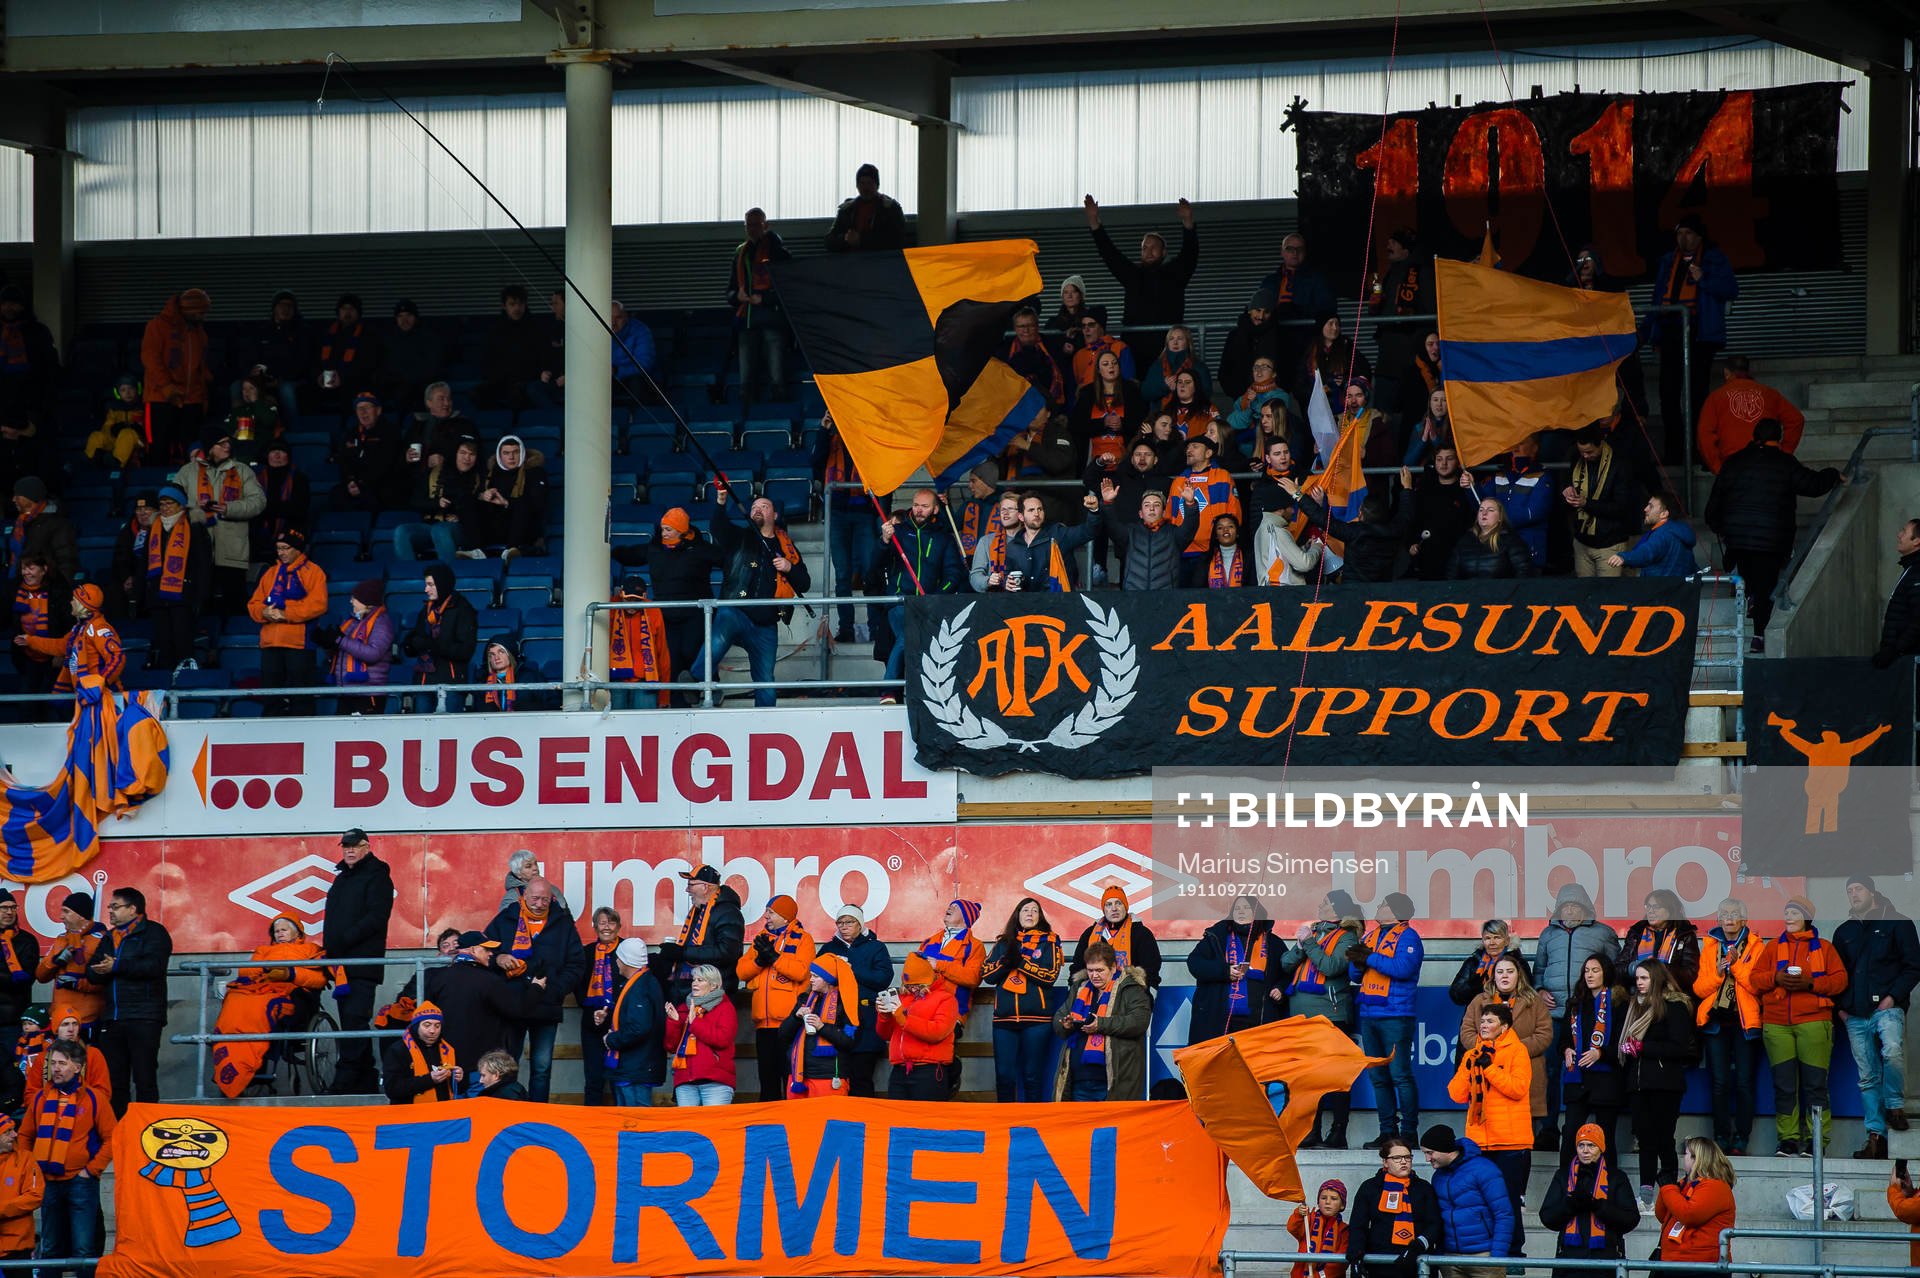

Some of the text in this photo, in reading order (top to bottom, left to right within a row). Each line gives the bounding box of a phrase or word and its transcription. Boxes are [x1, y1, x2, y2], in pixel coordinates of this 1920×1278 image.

[1355, 91, 1768, 276] 1914
[967, 614, 1091, 717] AFK
[1151, 600, 1686, 657] AALESUND
[1175, 685, 1649, 742] SUPPORT
[334, 730, 928, 810] BUSENGDAL
[258, 1117, 1118, 1264] STORMEN
